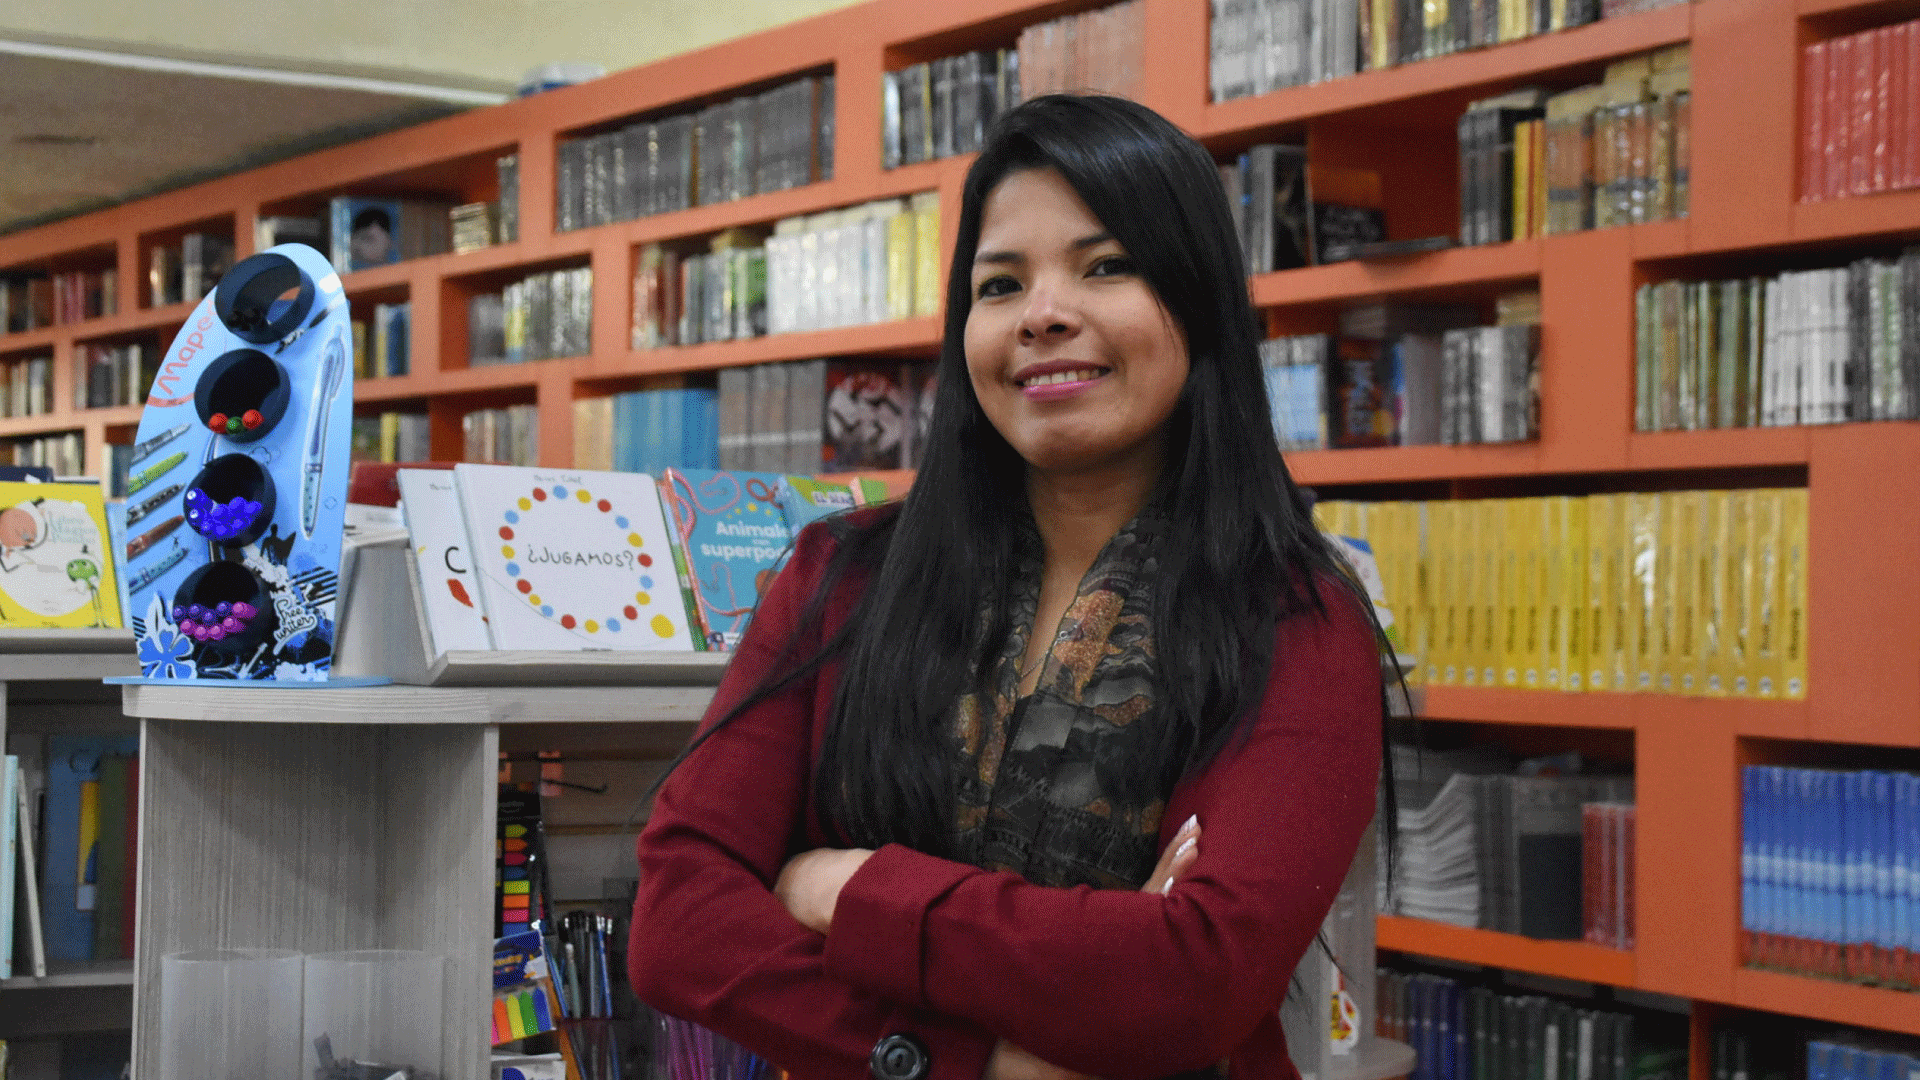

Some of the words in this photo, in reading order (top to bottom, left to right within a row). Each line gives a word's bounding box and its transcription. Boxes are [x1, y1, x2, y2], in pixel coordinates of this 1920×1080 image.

[528, 544, 634, 571] ¿JUGAMOS?
[276, 599, 304, 627] Free
[276, 615, 315, 639] writer
